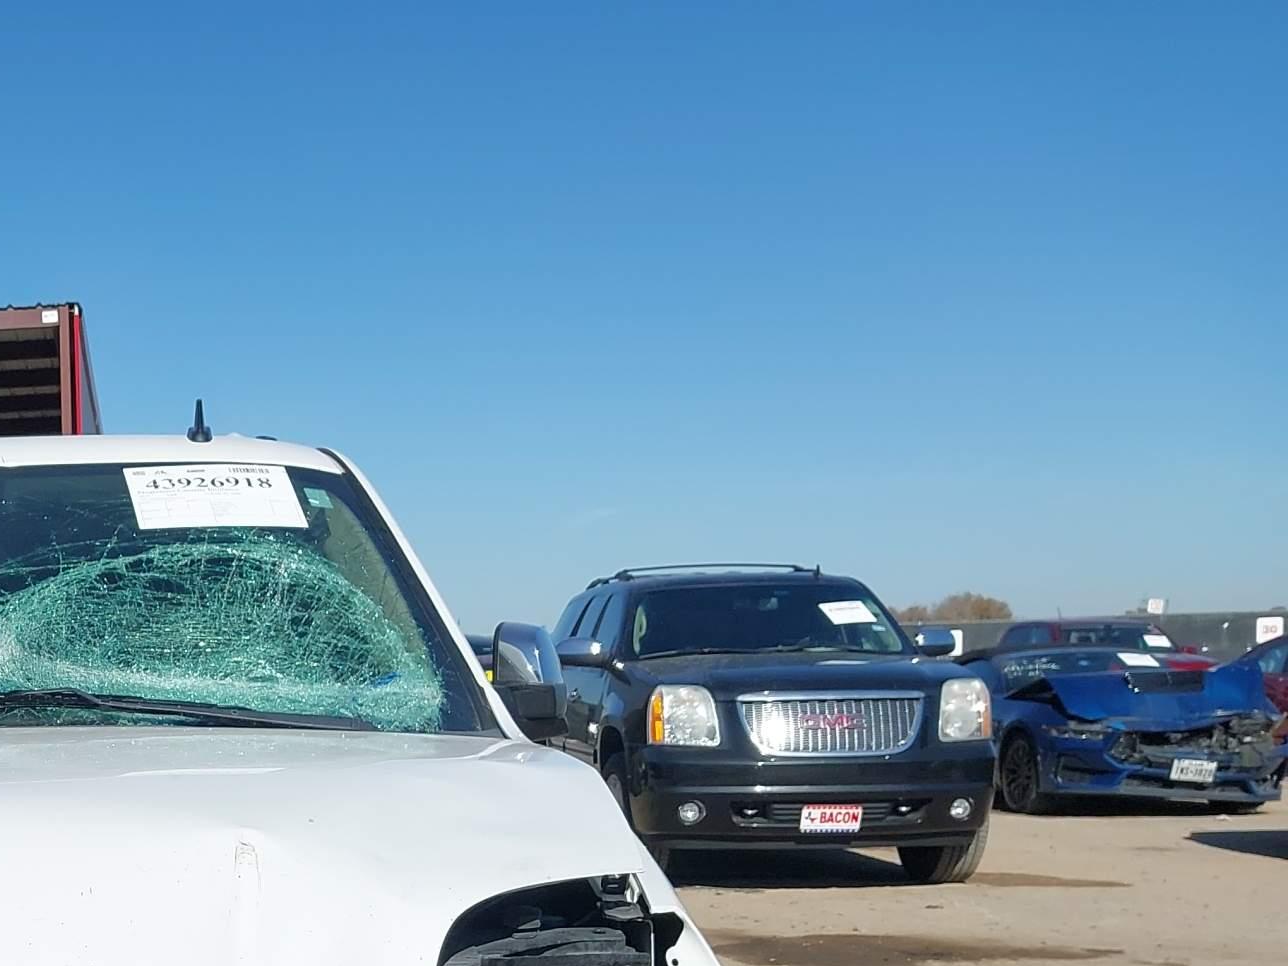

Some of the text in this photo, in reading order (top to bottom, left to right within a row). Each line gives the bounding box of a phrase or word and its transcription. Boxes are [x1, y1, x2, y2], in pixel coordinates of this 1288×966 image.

[145, 476, 273, 489] 43926918
[799, 713, 867, 730] GMC
[819, 810, 860, 824] BACON
